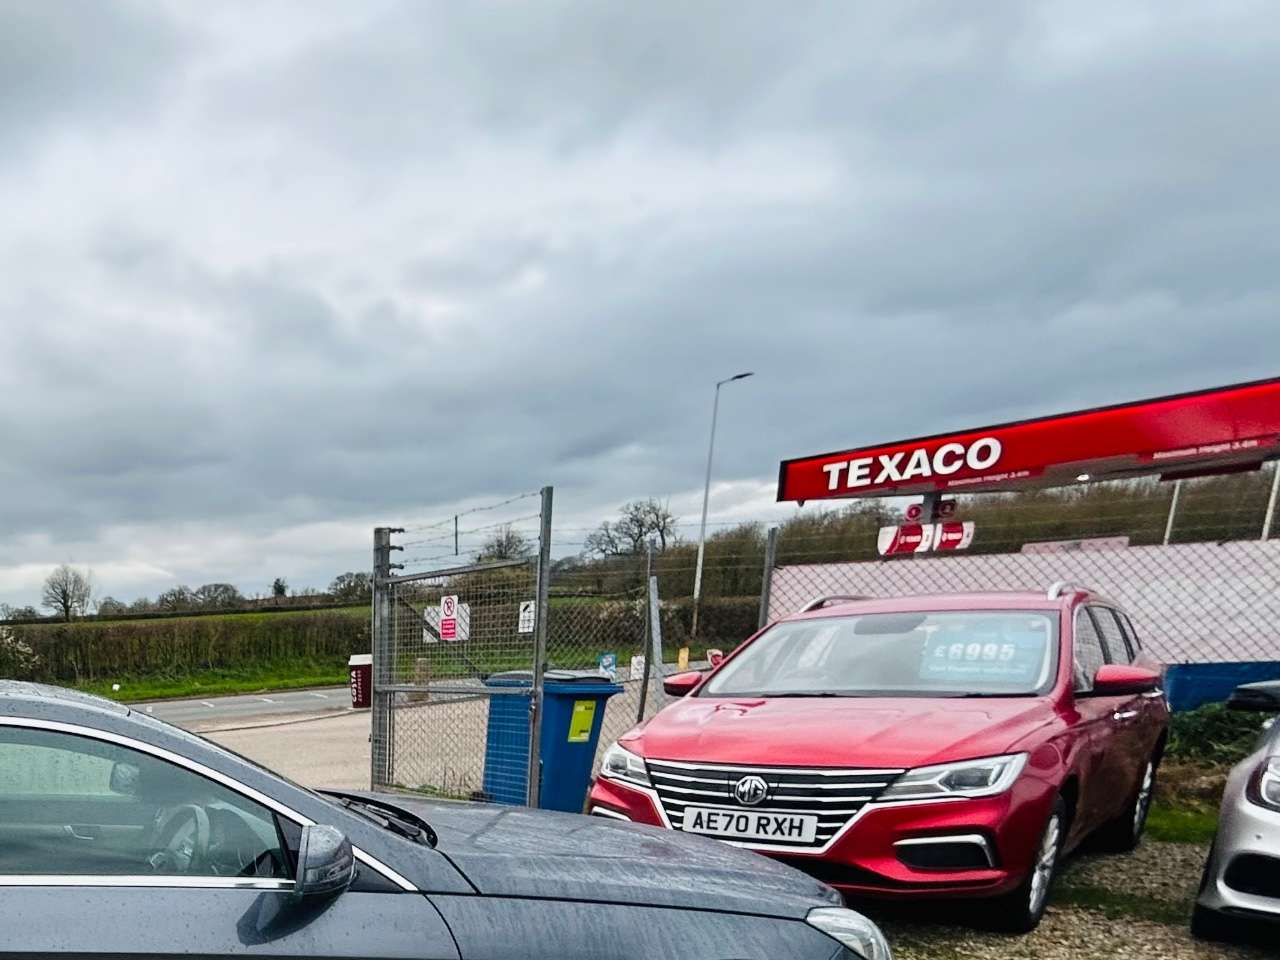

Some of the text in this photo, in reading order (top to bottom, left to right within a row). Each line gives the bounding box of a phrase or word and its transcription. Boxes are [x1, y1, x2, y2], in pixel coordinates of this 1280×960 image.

[822, 437, 1002, 490] TEXACO
[933, 642, 1015, 661] £6995
[692, 811, 804, 837] AE70 RXH
